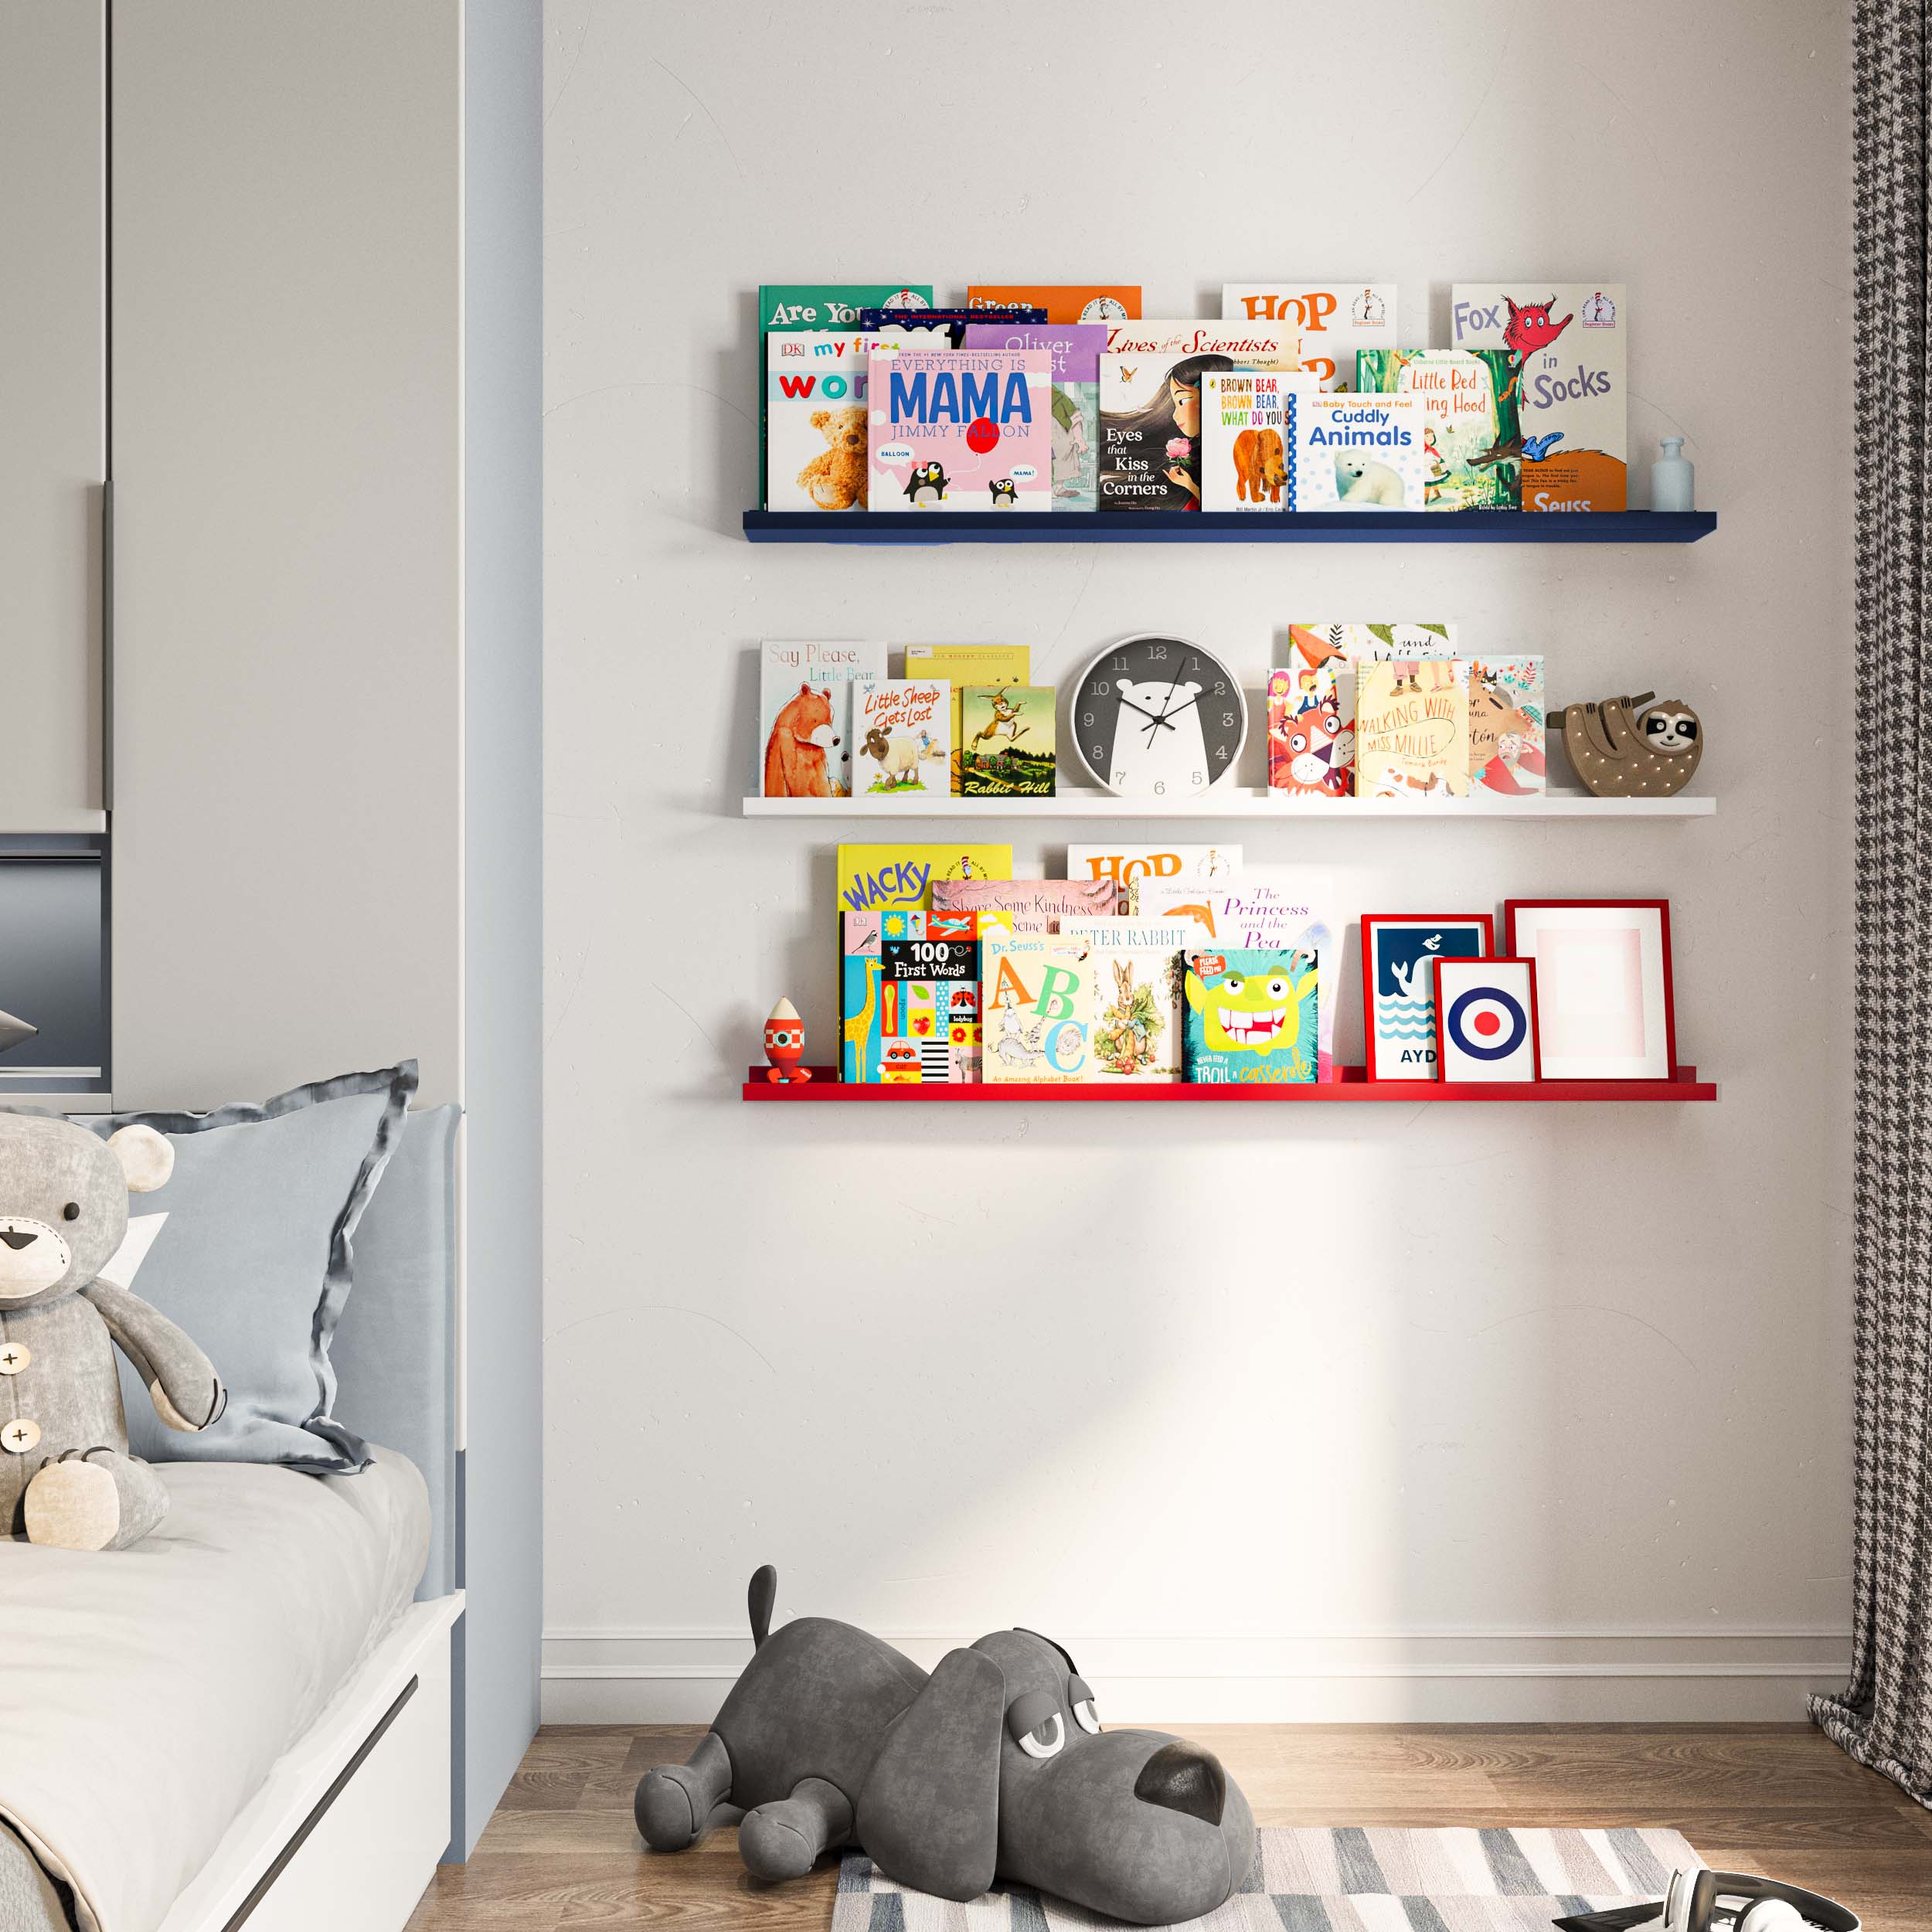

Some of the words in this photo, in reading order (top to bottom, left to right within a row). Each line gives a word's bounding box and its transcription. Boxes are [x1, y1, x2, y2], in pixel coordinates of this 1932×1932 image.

[768, 303, 817, 325] Are
[1241, 293, 1337, 332] HOP
[1454, 301, 1502, 341] Fox
[1005, 333, 1073, 353] Oliver
[1107, 328, 1158, 352] Lives
[1168, 334, 1181, 346] the
[1182, 330, 1279, 352] Scientists
[814, 342, 845, 358] my
[892, 360, 1003, 370] EVERYTHING
[1011, 360, 1026, 370] IS
[1543, 353, 1557, 369] in
[1221, 379, 1252, 393] BROWN
[1256, 379, 1280, 393] BEAR,
[1413, 371, 1447, 389] Little
[1451, 369, 1476, 390] Red
[1533, 365, 1611, 409] Socks
[890, 372, 1032, 423] MAMA
[1221, 396, 1252, 410] BROWN
[1257, 395, 1279, 409] BEAR,
[1323, 400, 1345, 409] Baby
[1454, 393, 1485, 413] Hood
[1221, 411, 1248, 425] WHAT
[1252, 411, 1264, 425] DO
[1266, 411, 1282, 425] YOU
[1332, 409, 1389, 426] Cuddly
[891, 426, 950, 440] JIMMY
[957, 426, 1029, 437] FALLON
[1107, 428, 1142, 444] Eyes
[1308, 425, 1412, 446] Animals
[1107, 444, 1127, 454] that
[1115, 457, 1148, 470] Kiss
[1128, 472, 1137, 481] in
[1140, 472, 1155, 481] the
[1104, 482, 1168, 495] Corners
[1400, 635, 1434, 647] und
[770, 644, 799, 667] Say
[805, 644, 860, 664] Please,
[1148, 646, 1167, 659] 12
[1112, 658, 1129, 670] 11
[1192, 658, 1200, 670] 1
[810, 668, 842, 681] Little
[846, 668, 874, 681] Bear
[1091, 682, 1109, 696] 10
[1214, 682, 1226, 696] 2
[865, 691, 900, 715] Little
[902, 686, 940, 707] Sheep
[874, 711, 906, 727] Gets
[907, 706, 932, 727] Lost
[1083, 713, 1094, 726] 9
[1223, 713, 1233, 726] 3
[1359, 701, 1418, 733] WALKING
[1425, 699, 1455, 719] WITH
[1093, 746, 1104, 759] 8
[1216, 746, 1227, 759] 4
[1368, 736, 1391, 750] MISS
[1395, 734, 1437, 756] MILLIE
[1115, 771, 1126, 784] 7
[1192, 771, 1202, 784] 5
[964, 781, 1014, 794] Rabbit
[1019, 781, 1051, 794] Hill
[1154, 781, 1165, 794] 6
[1086, 854, 1182, 891] HOP
[843, 861, 930, 910] WACKY
[1253, 888, 1280, 900] The
[952, 898, 992, 911] Share
[995, 895, 1031, 913] Some
[1035, 894, 1094, 916] Kindness
[1224, 898, 1309, 915] Princess
[1240, 917, 1265, 928] and
[1268, 917, 1287, 928] the
[1070, 930, 1121, 946] TER
[1128, 930, 1188, 946] RABBIT
[1244, 931, 1281, 948] Pea
[910, 943, 949, 962] 100
[992, 943, 1008, 955] Dr.
[1009, 940, 1046, 952] Seuss's
[1199, 956, 1219, 966] PLEASE
[894, 961, 926, 978] First
[929, 963, 965, 977] Words
[1199, 966, 1214, 975] FEED
[1197, 1055, 1212, 1065] NEVER
[1400, 1050, 1437, 1063] AYD
[1240, 1047, 1311, 1083] casserole
[1196, 1066, 1230, 1083] TROLL
